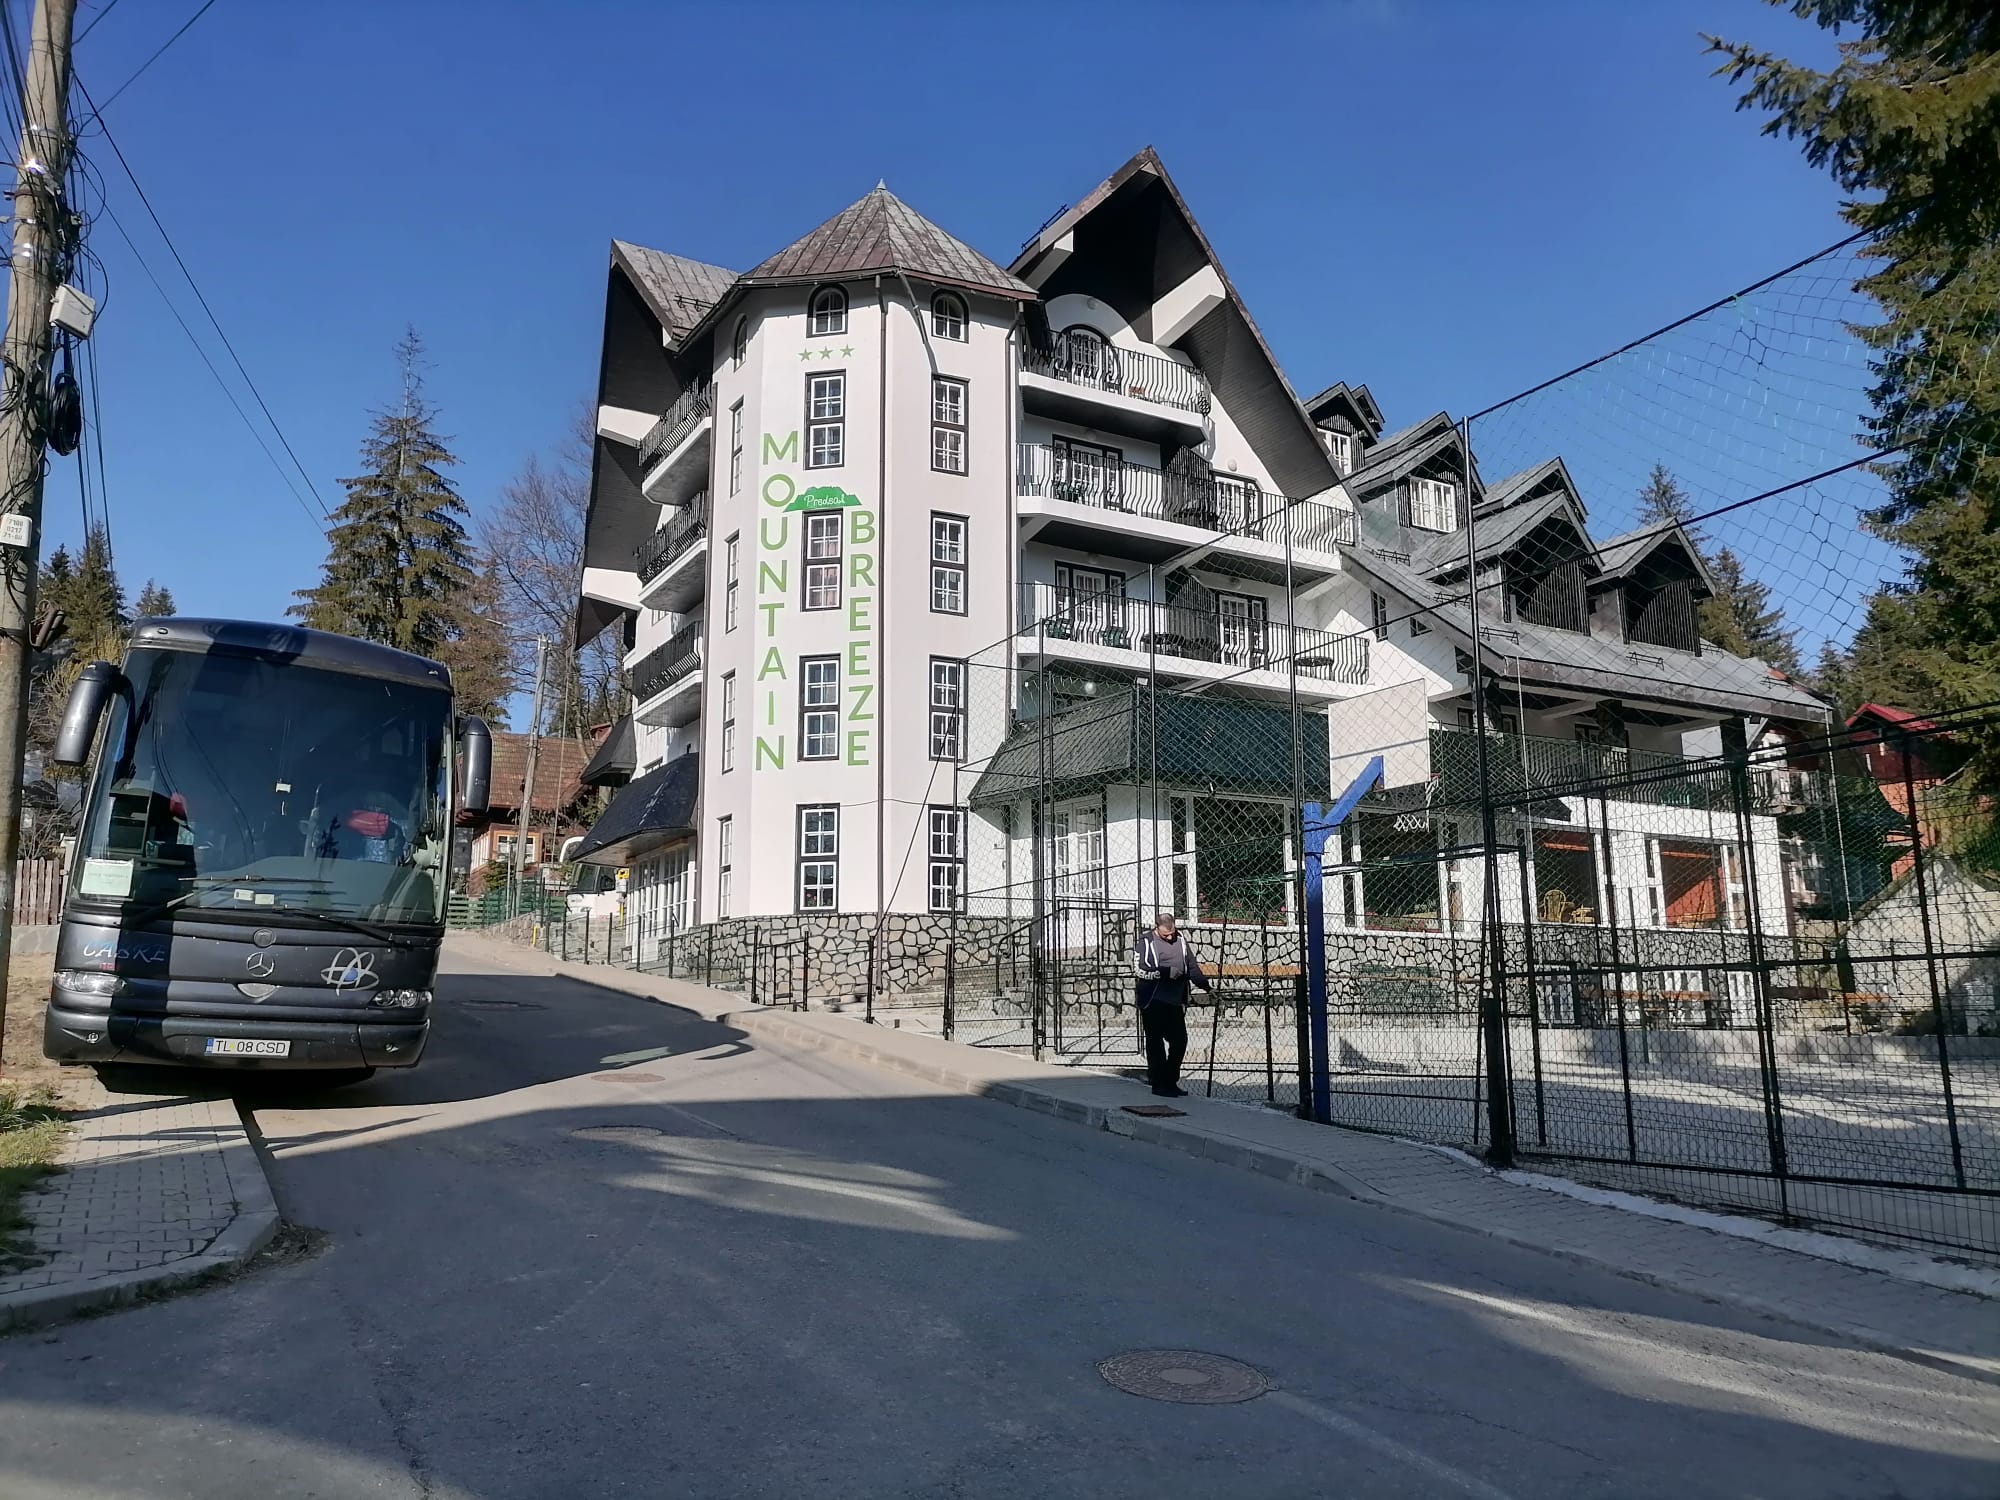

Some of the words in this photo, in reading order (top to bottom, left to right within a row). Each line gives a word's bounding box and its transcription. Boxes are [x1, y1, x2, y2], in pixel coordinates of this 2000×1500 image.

[804, 493, 846, 509] Predeal
[755, 430, 798, 770] MOUNTAIN
[847, 510, 876, 767] BREEZE
[215, 1040, 231, 1053] TL
[236, 1041, 253, 1053] 08
[255, 1042, 286, 1054] CSD
